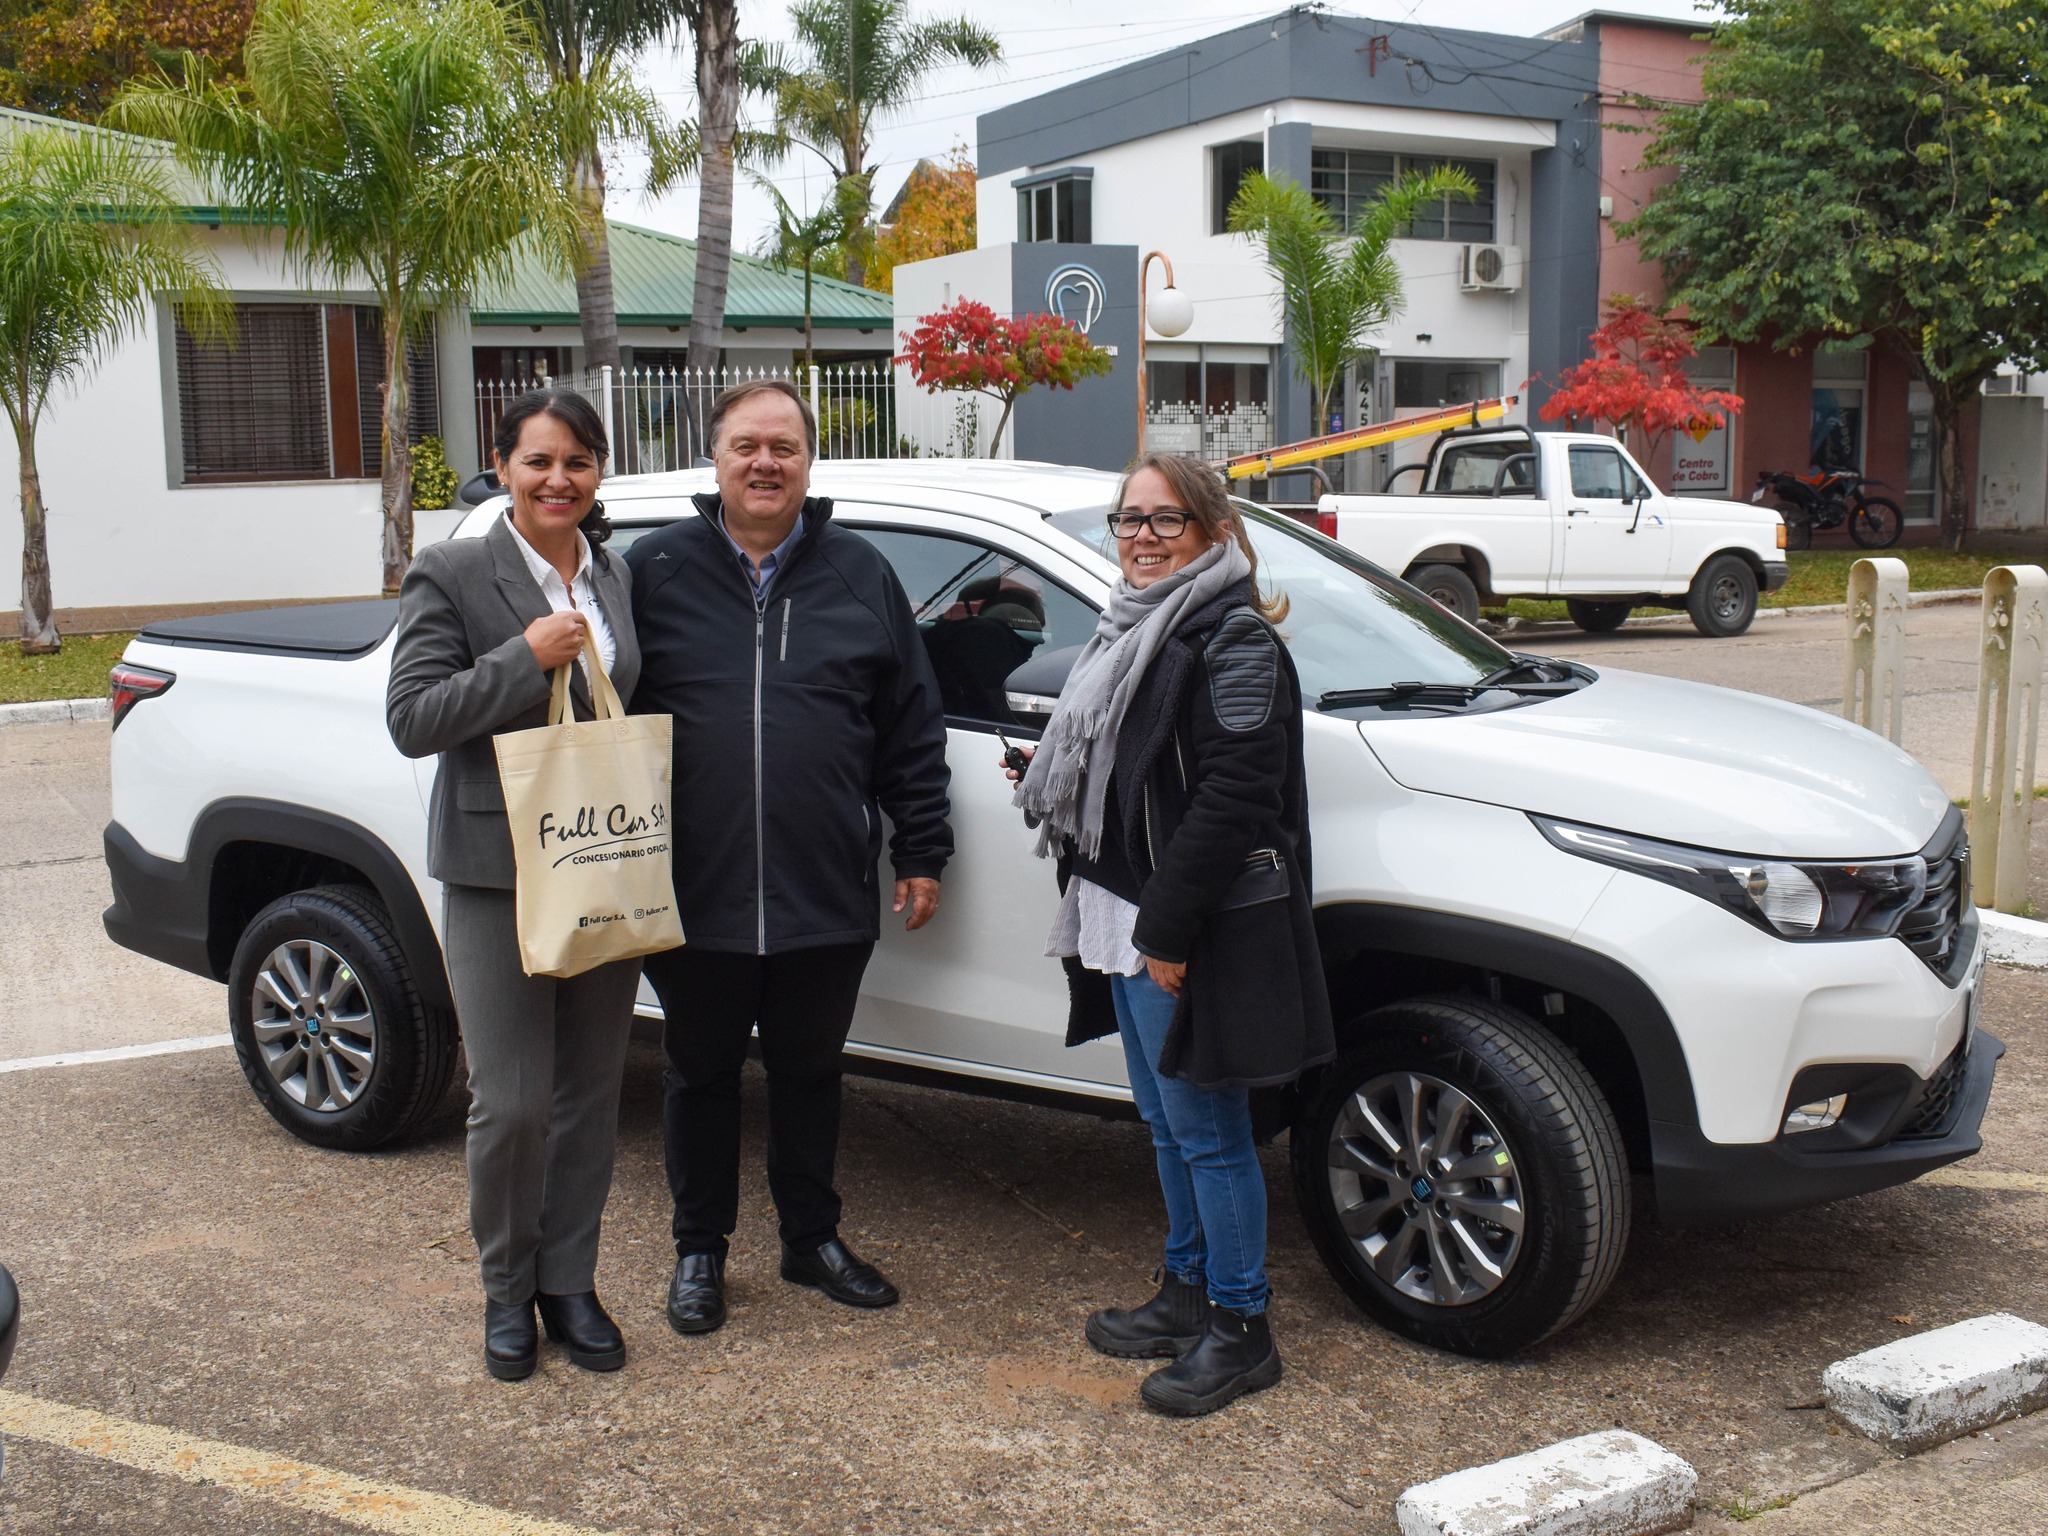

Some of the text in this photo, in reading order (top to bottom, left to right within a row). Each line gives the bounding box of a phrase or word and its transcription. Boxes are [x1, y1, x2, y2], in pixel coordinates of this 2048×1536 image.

[1360, 381, 1370, 426] 445
[1679, 458, 1714, 469] Centro
[1672, 470, 1719, 481] de Cobro
[539, 806, 598, 849] Full
[607, 804, 649, 836] Car
[572, 848, 645, 865] CONCESIONARIO
[590, 916, 601, 924] Full
[602, 915, 613, 923] Car
